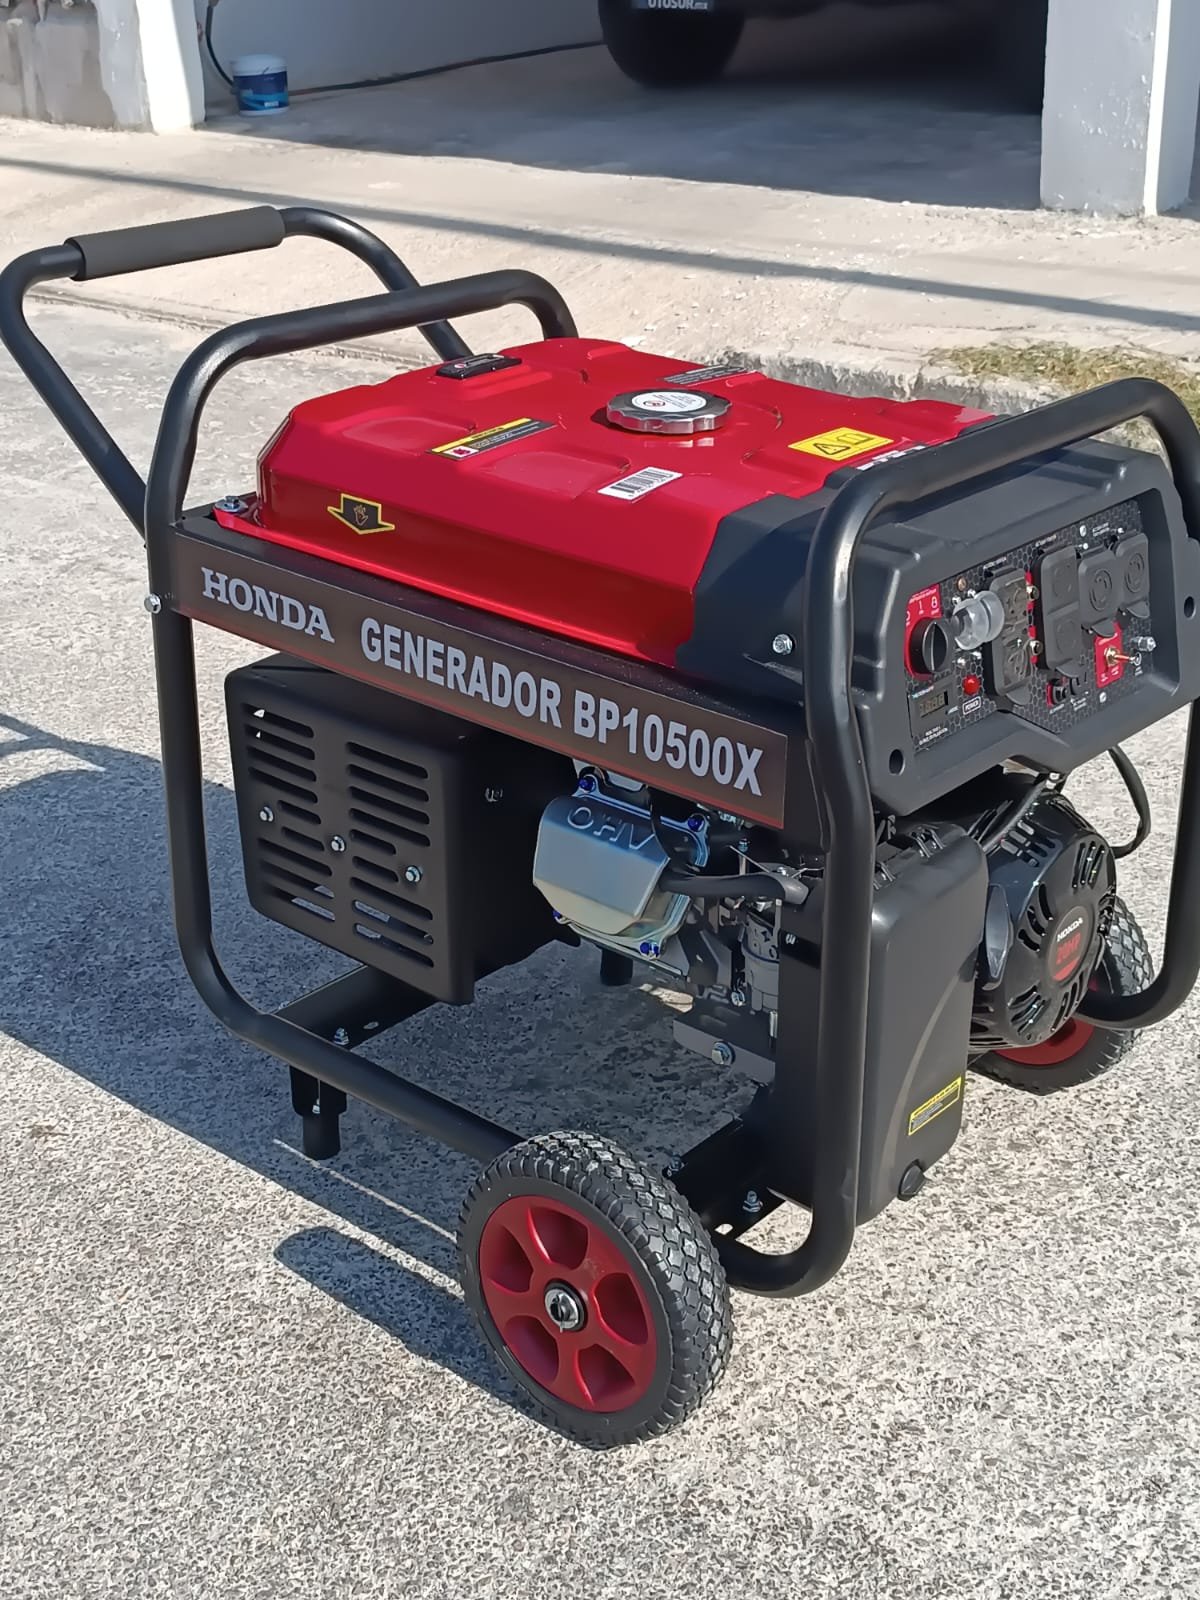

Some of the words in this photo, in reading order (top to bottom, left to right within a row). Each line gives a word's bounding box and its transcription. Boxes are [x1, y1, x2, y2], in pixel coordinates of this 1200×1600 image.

[201, 567, 335, 643] HONDA
[361, 617, 562, 728] GENERADOR
[574, 689, 763, 796] BP10500X
